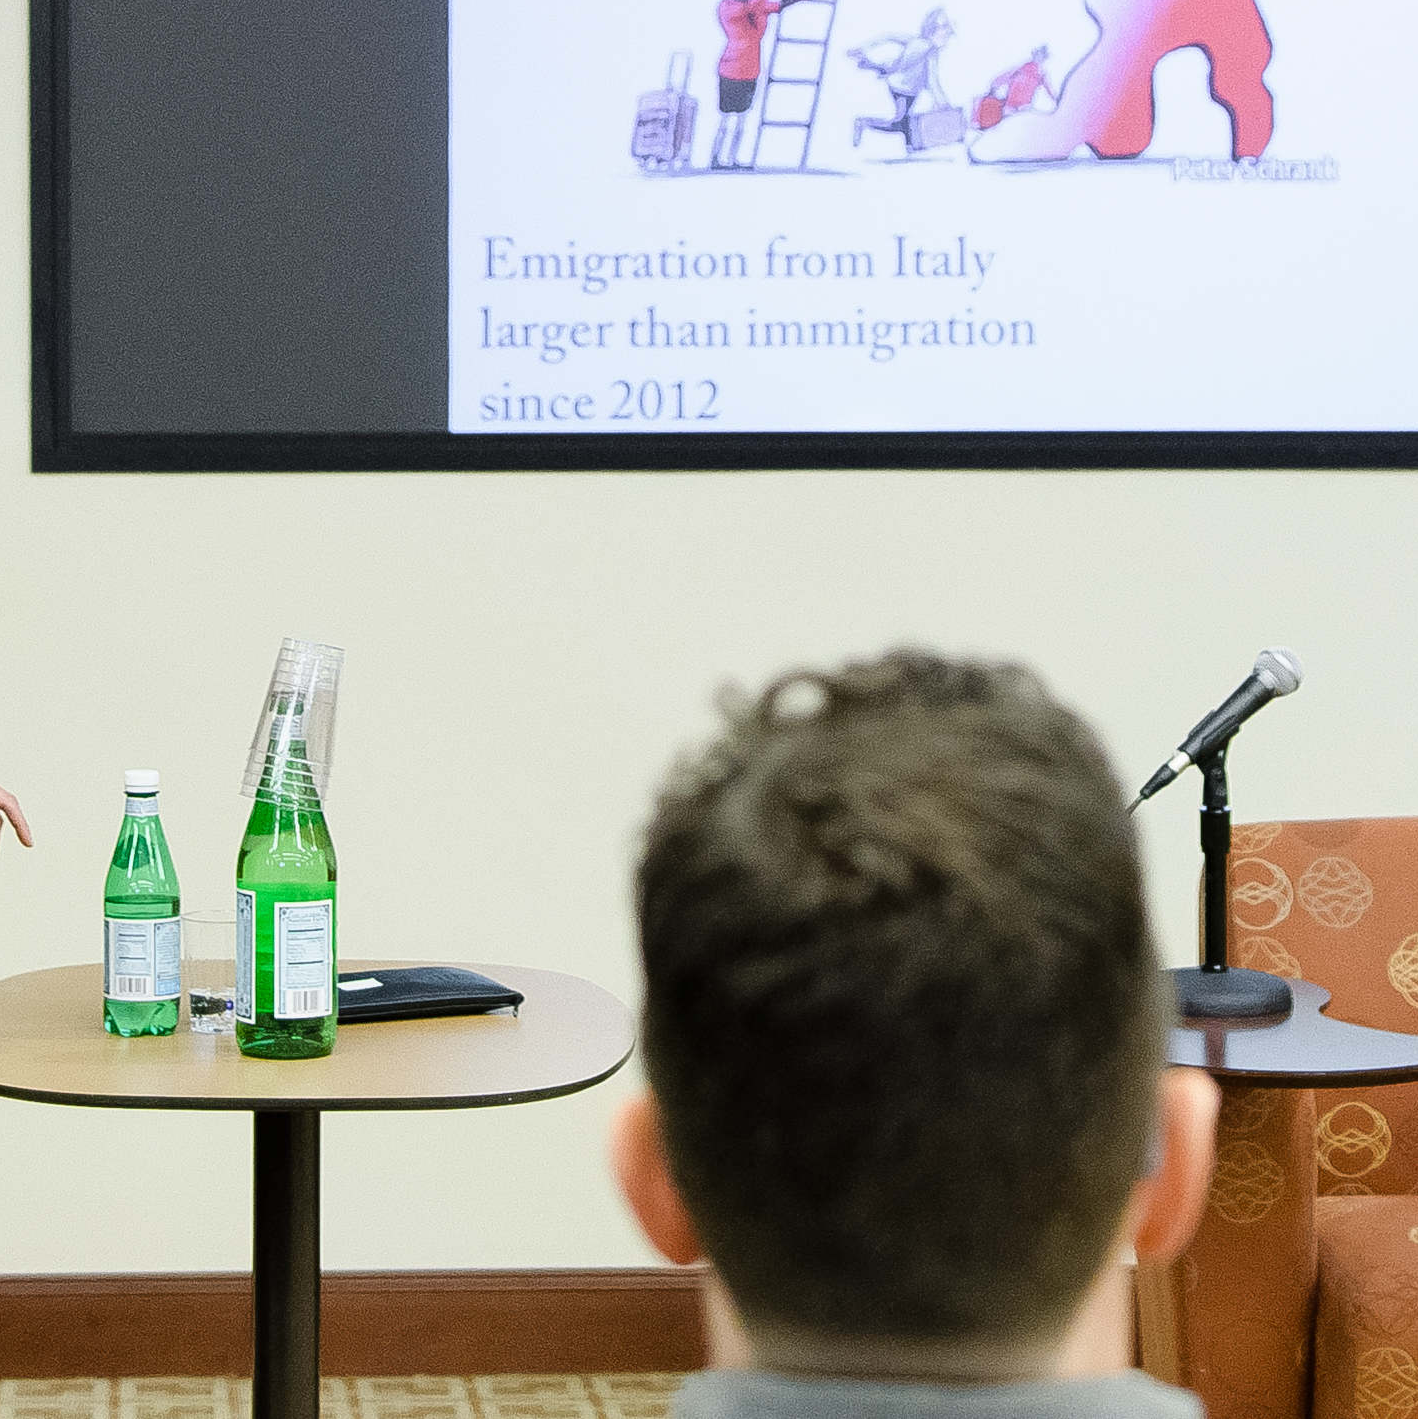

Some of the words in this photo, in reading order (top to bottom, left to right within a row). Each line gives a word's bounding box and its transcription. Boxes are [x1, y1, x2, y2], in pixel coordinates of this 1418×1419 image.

[481, 235, 751, 295] Emigration
[763, 232, 878, 280] from
[892, 232, 997, 294] Italy
[479, 303, 617, 365] larger
[626, 303, 733, 350] than
[745, 303, 1039, 365] immigration
[479, 378, 597, 423] since
[607, 376, 723, 423] 2012
